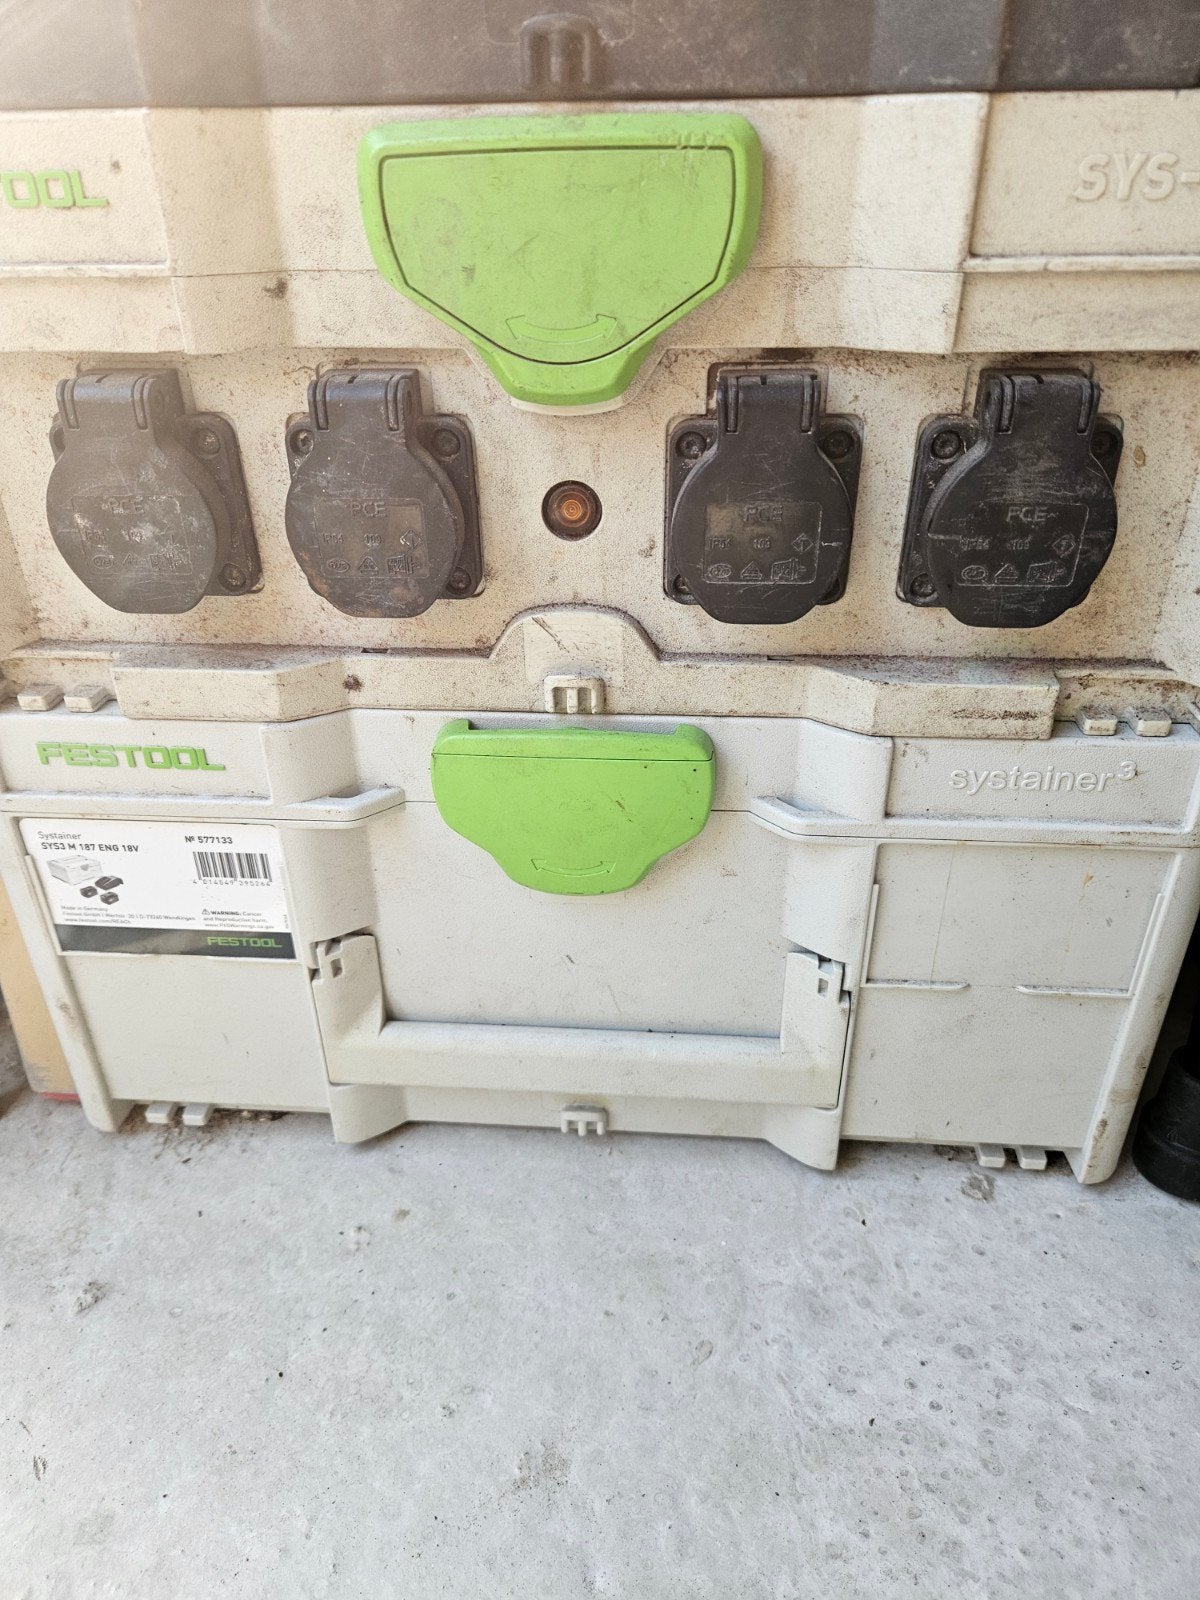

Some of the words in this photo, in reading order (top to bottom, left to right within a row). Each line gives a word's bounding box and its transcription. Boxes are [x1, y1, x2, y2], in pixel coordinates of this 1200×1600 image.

[0, 169, 110, 210] OOL
[352, 500, 387, 518] PCE
[743, 504, 783, 521] PCE
[1005, 506, 1048, 522] PCE
[36, 741, 226, 770] FESTOOL
[37, 830, 82, 841] Systainer
[197, 835, 233, 844] 577133
[40, 842, 66, 850] SYS3
[79, 843, 95, 851] 187
[98, 844, 119, 852] ENG
[206, 936, 283, 948] FESTOOL
